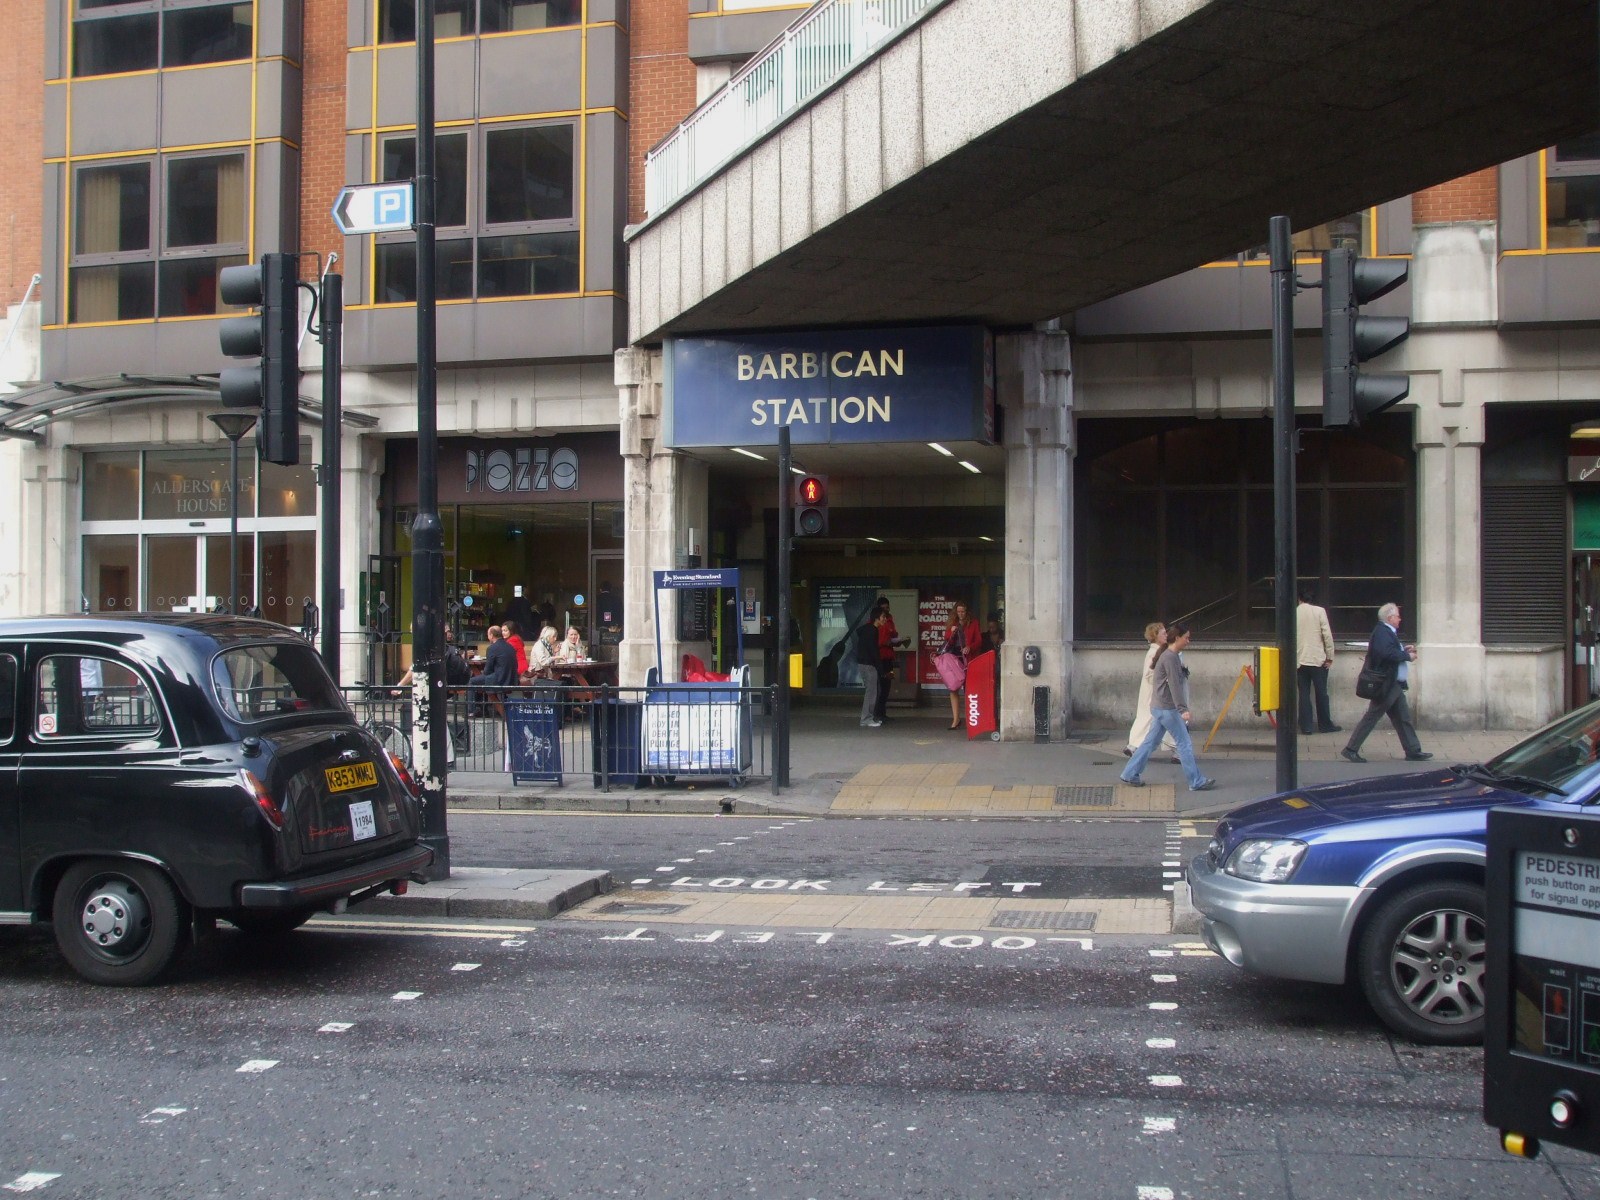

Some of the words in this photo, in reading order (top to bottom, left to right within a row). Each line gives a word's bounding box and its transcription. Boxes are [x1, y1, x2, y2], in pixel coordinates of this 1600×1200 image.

[380, 193, 400, 222] P
[737, 349, 904, 381] BARBICAN
[751, 395, 891, 426] STATION
[151, 479, 249, 494] ALDERSGAE
[177, 498, 227, 513] HOUSE
[355, 815, 373, 828] 11984
[1526, 856, 1600, 879] PEDESTRI
[670, 876, 832, 891] LOOK
[866, 881, 1042, 893] LEFT
[1525, 876, 1549, 886] push
[1552, 878, 1586, 891] button
[1530, 889, 1545, 899] for
[1548, 891, 1578, 905] signal
[599, 927, 834, 944] LEFT
[890, 934, 1094, 951] LOOK
[1549, 968, 1566, 977] wait
